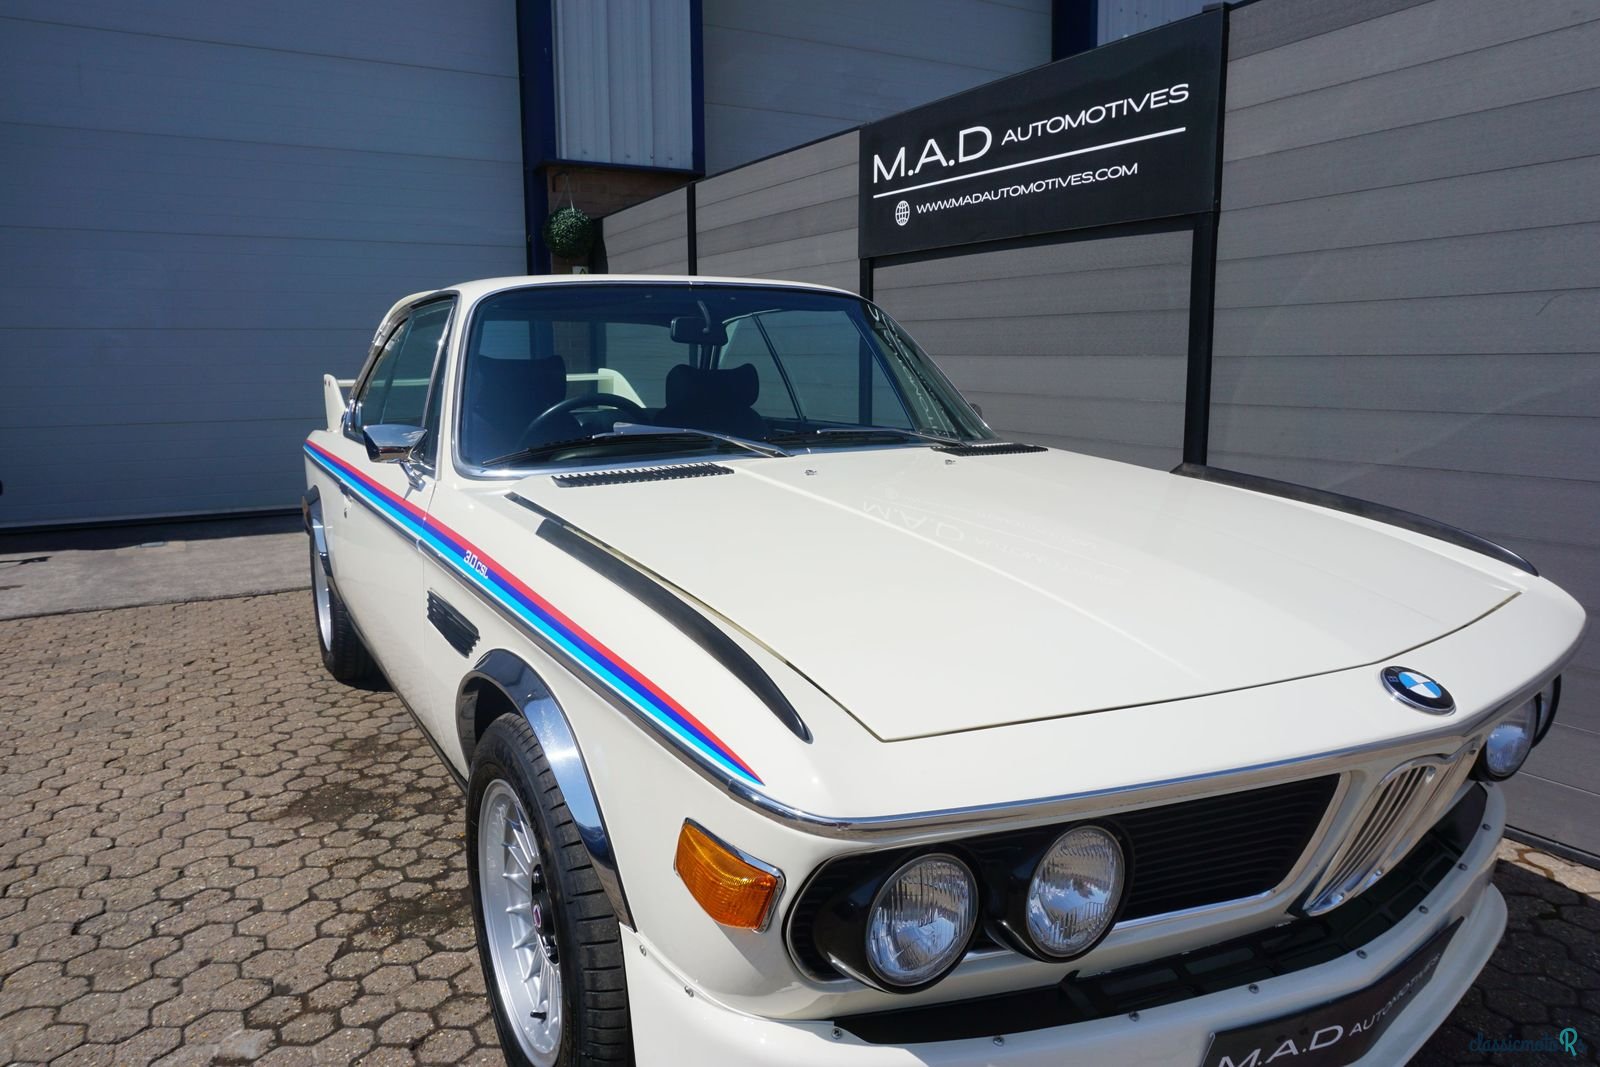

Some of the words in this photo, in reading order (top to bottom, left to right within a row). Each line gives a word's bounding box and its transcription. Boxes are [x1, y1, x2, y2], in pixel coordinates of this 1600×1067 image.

[873, 126, 993, 184] M.A.D
[1001, 83, 1190, 146] AUTOMOTIVES
[916, 162, 1139, 214] WWW.MADAUTOMOTIVES.COM
[1217, 1024, 1344, 1067] M.A.D
